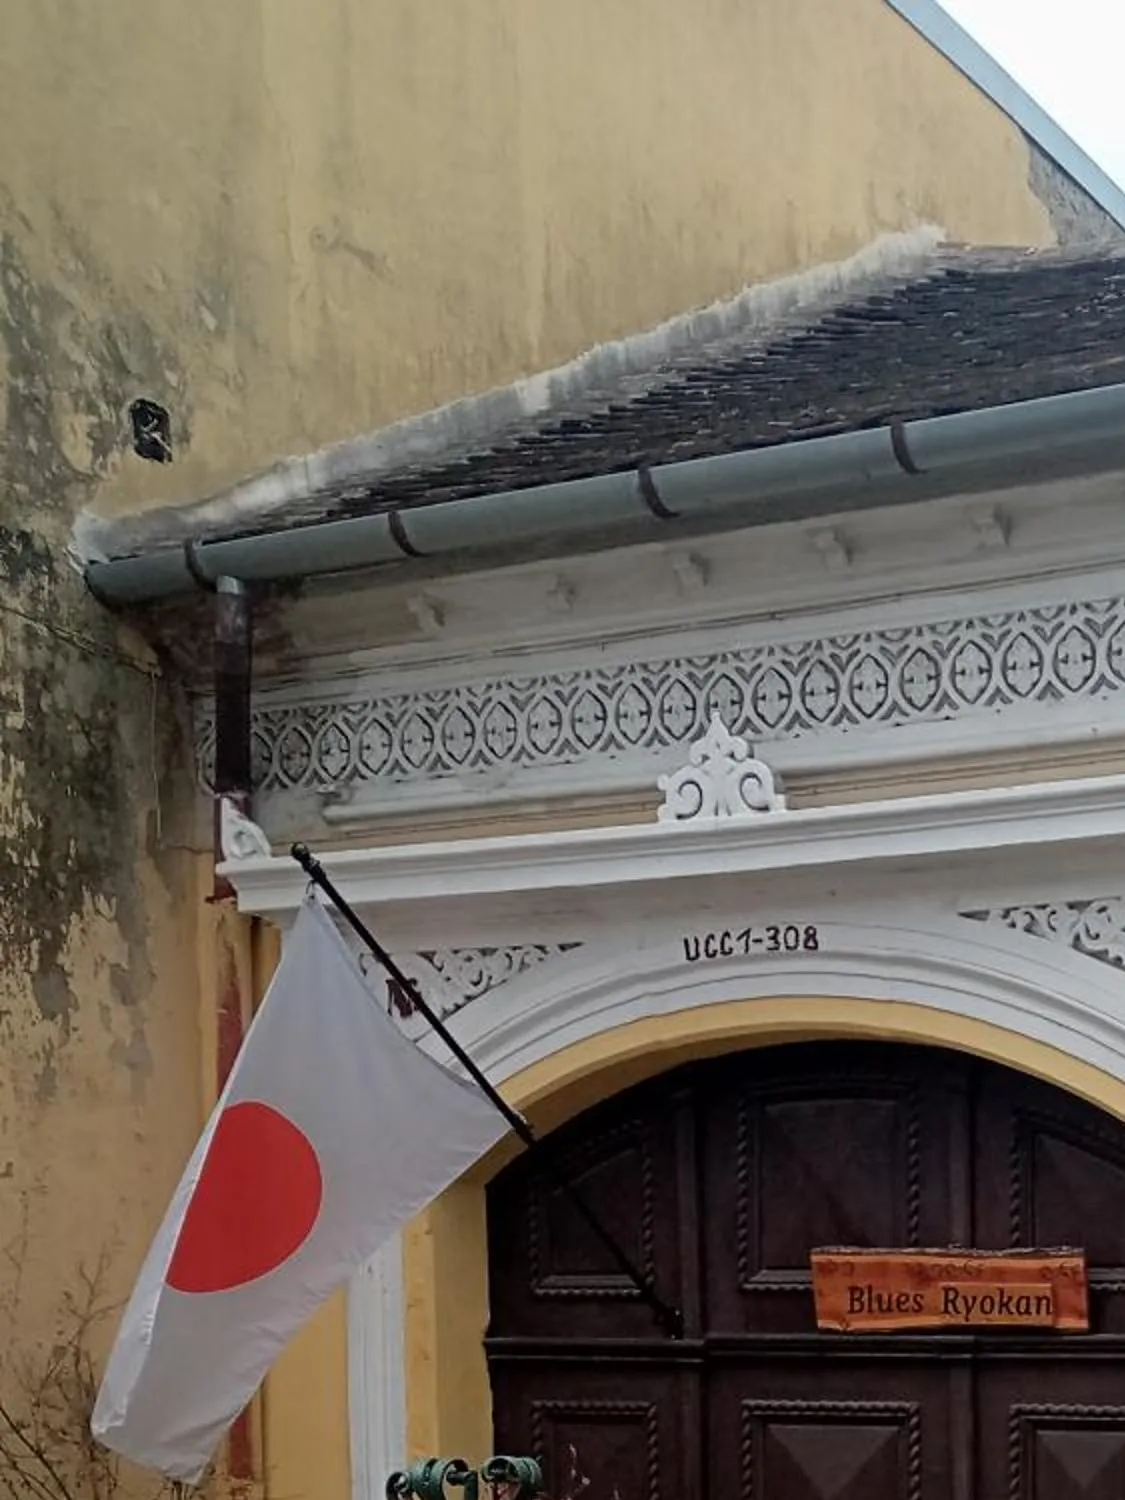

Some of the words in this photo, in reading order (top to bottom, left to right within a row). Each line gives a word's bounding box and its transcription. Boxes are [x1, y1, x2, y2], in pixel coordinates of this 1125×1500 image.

[682, 925, 819, 962] UCC1-308
[846, 1284, 925, 1315] Blues
[940, 1285, 1053, 1323] Ryokan
